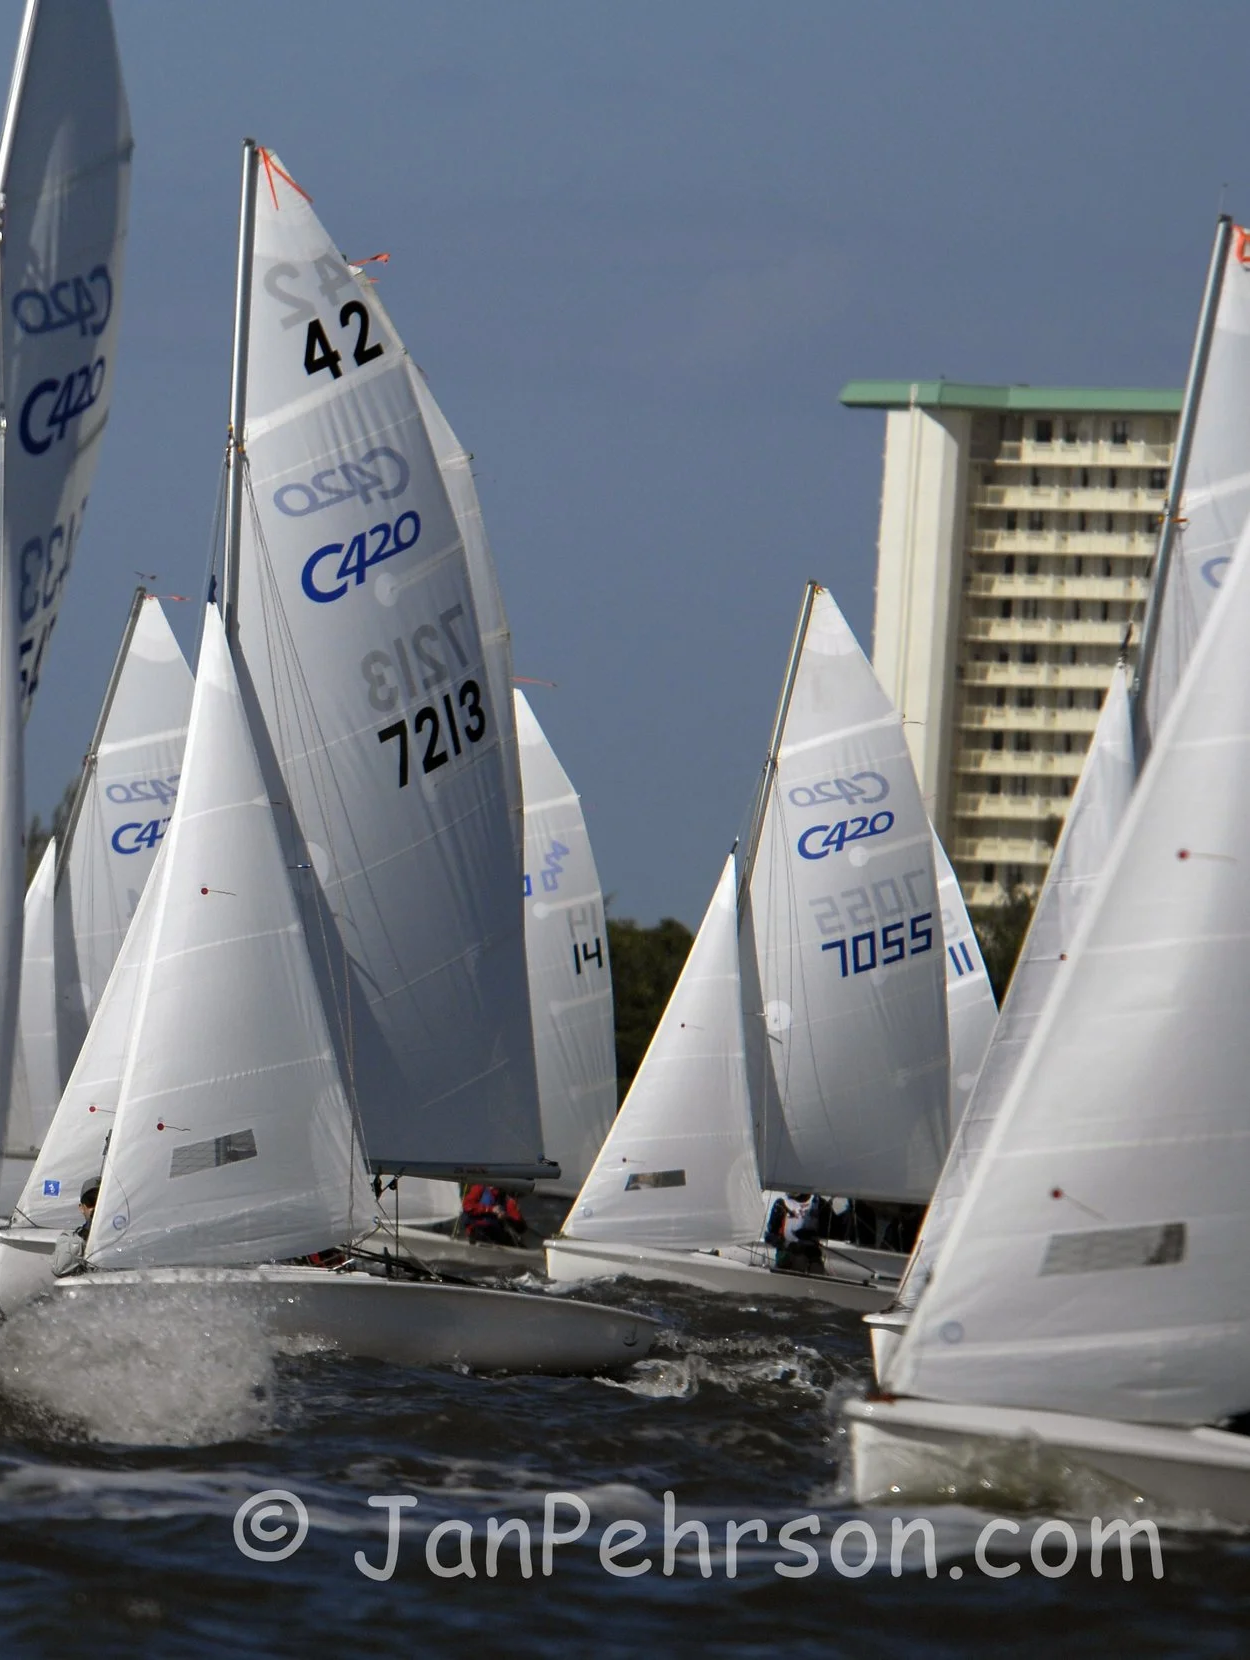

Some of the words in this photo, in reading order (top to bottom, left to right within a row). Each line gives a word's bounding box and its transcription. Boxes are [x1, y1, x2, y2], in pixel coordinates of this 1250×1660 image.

[304, 300, 384, 380] 42
[19, 355, 105, 455] C420
[302, 510, 421, 603] C420
[377, 680, 485, 788] 7213
[111, 816, 171, 854] C4
[797, 811, 894, 860] C420
[574, 937, 603, 975] 14
[821, 912, 932, 978] 7055
